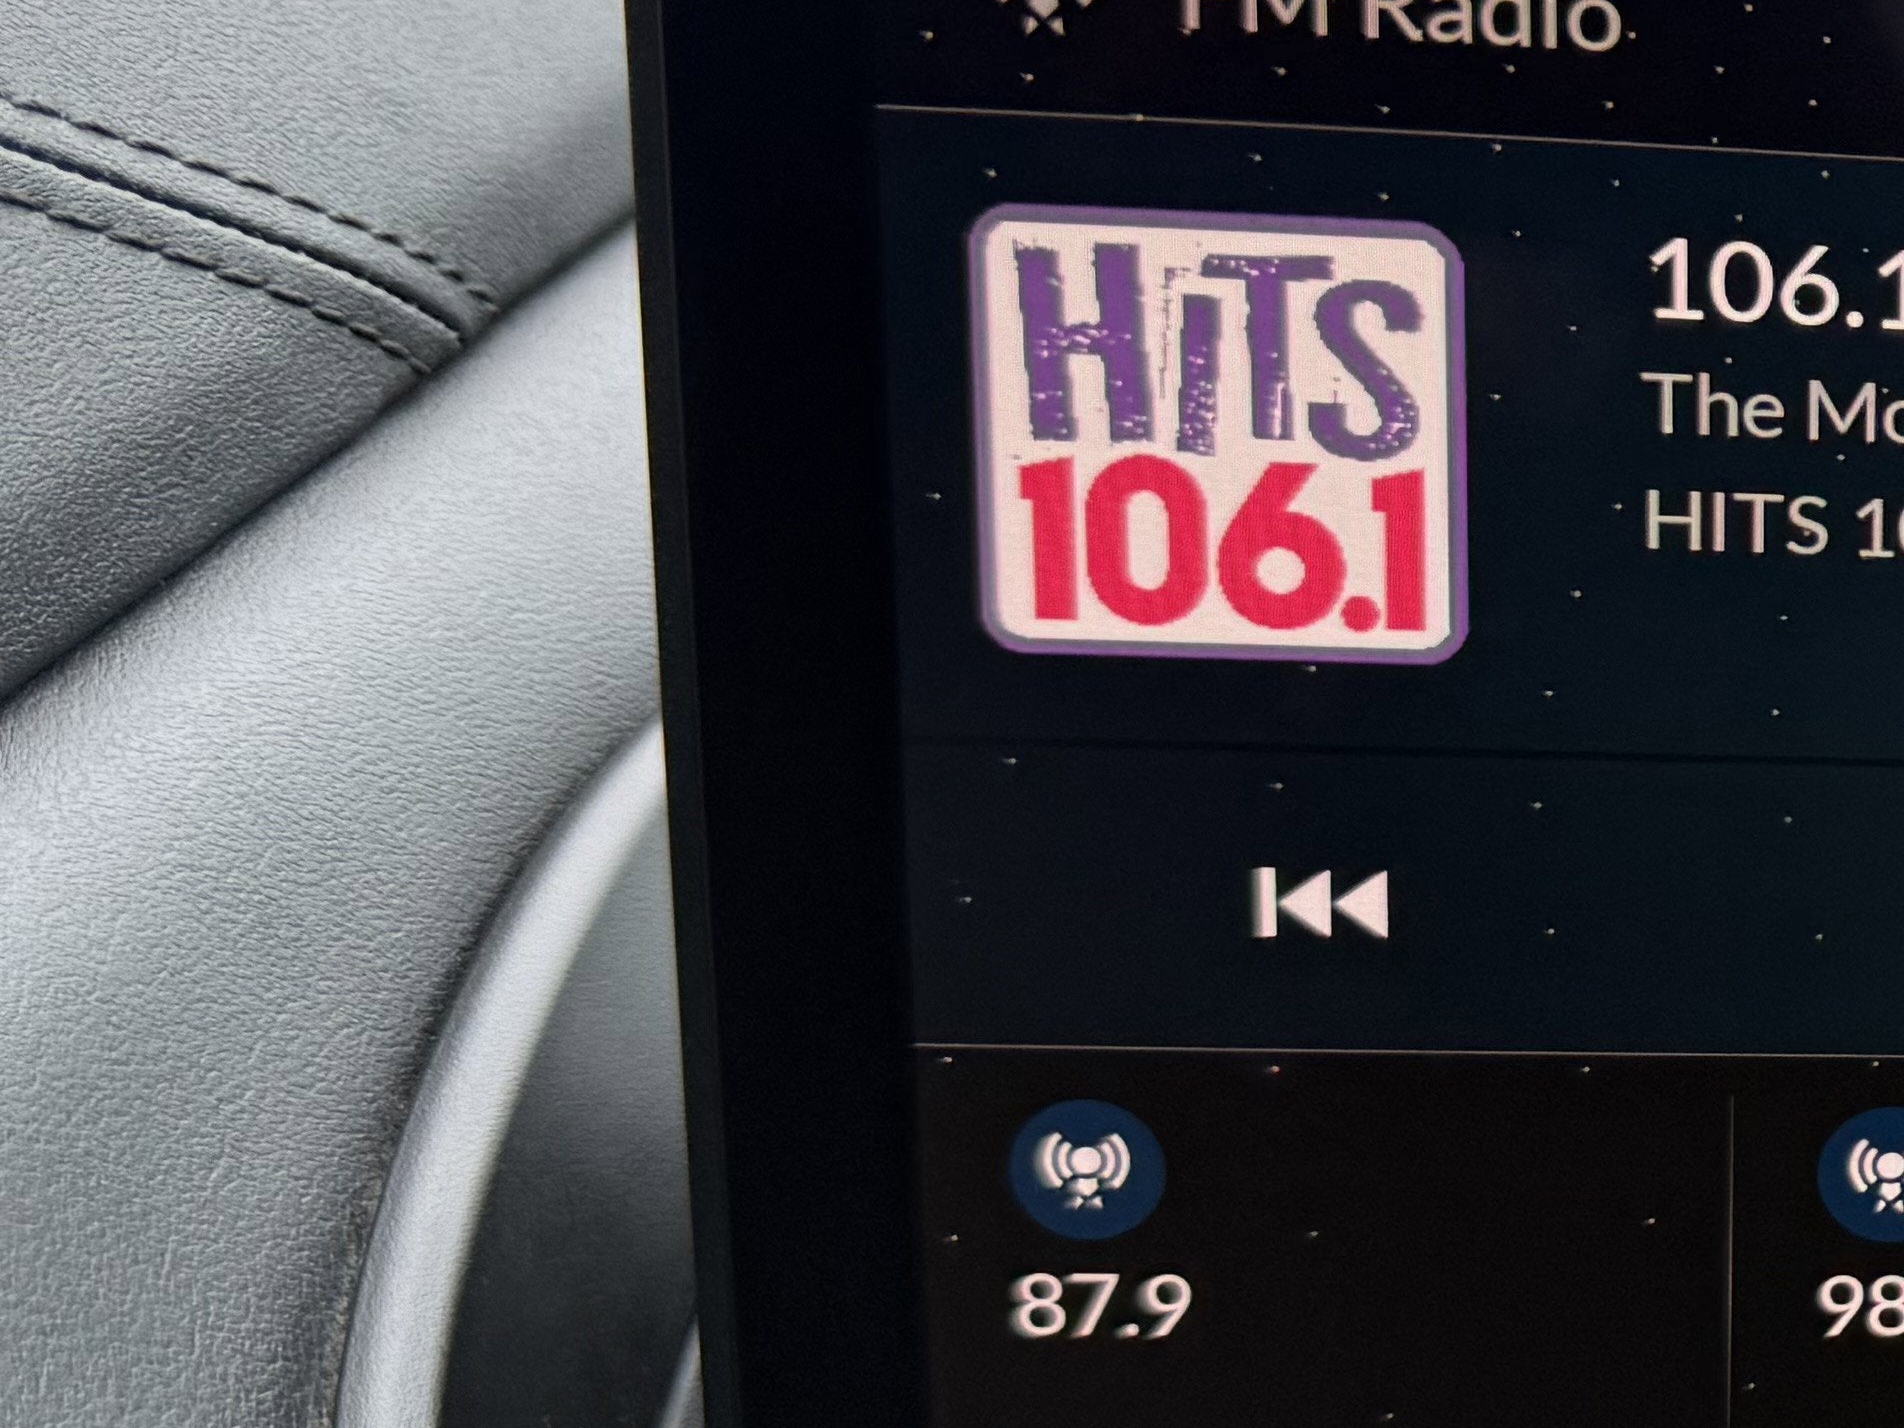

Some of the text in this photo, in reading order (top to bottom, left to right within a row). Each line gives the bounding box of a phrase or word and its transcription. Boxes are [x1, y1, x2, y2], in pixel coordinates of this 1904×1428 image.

[1641, 373, 1784, 437] The
[1018, 454, 1424, 631] 106.1
[1648, 490, 1828, 554] HITS
[1015, 1273, 1191, 1337] 87.9
